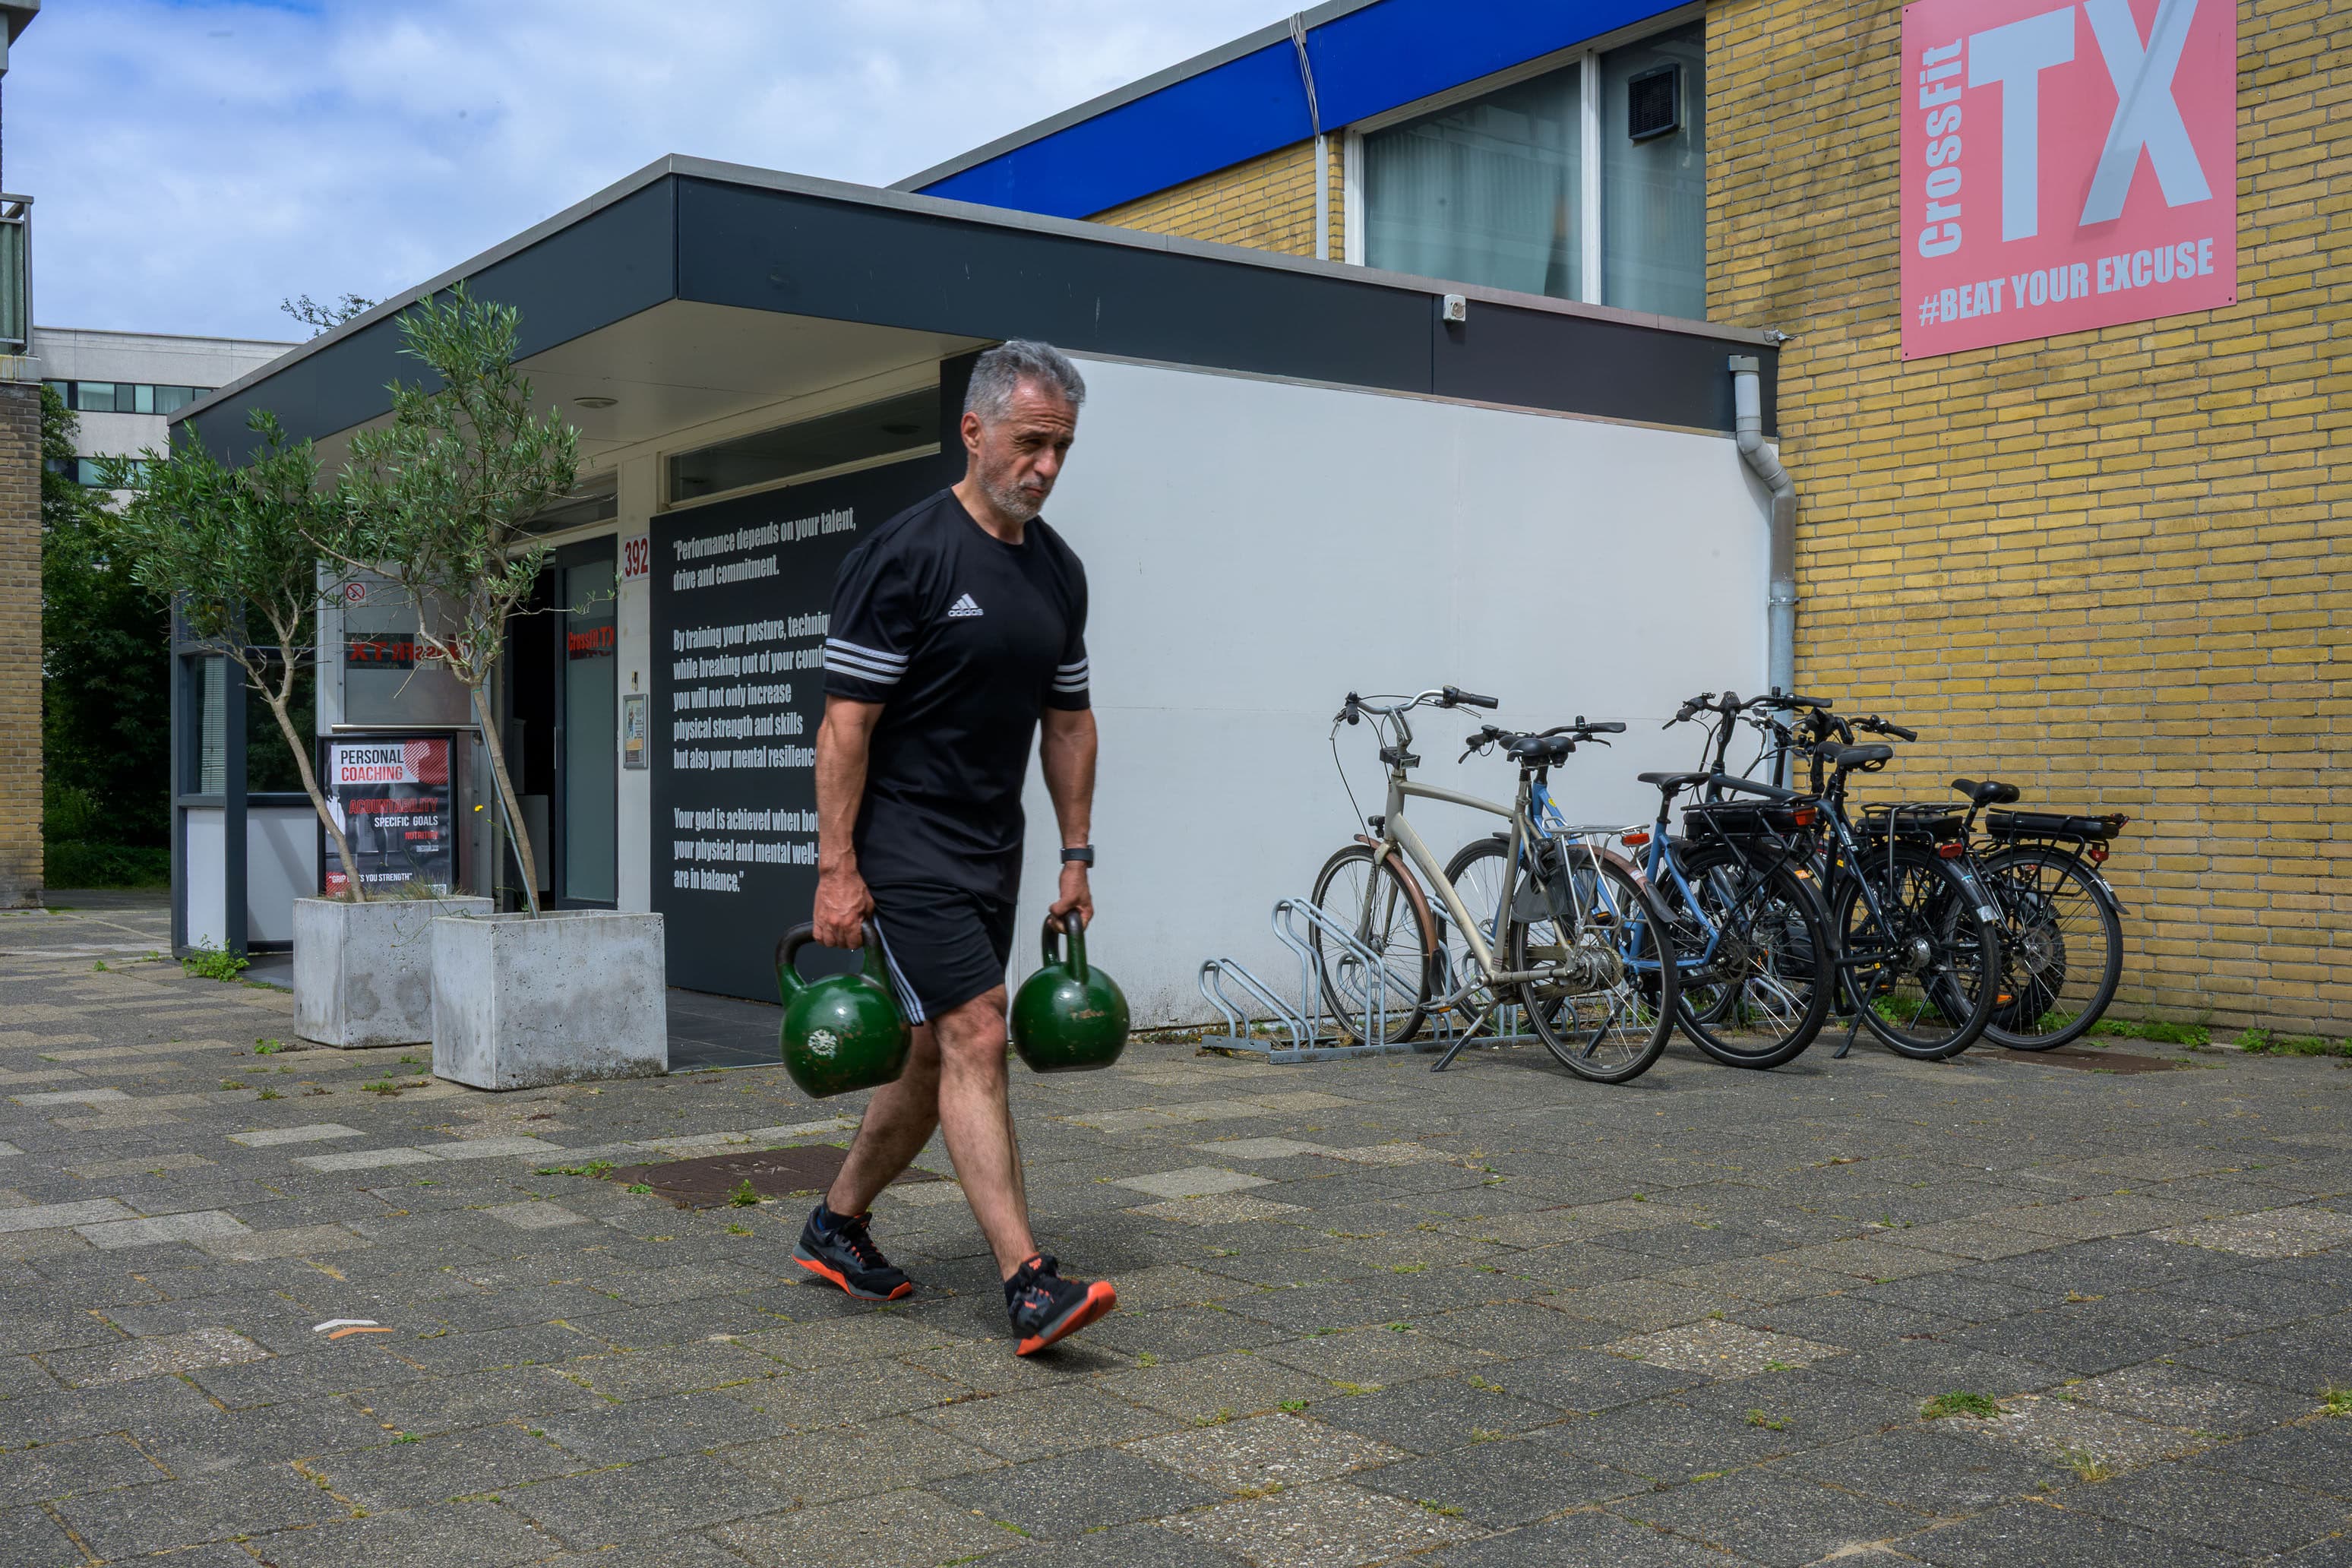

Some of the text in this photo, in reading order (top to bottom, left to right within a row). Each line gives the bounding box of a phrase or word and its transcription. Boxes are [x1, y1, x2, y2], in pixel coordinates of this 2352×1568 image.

[1968, 0, 2213, 242] TX
[1918, 38, 1962, 258] CrossFit
[1919, 238, 2214, 327] #BEAT YOUR EXCUSE
[736, 521, 779, 550] depends
[781, 521, 794, 542] on
[795, 516, 819, 541] your
[820, 507, 856, 534] talent,
[624, 537, 648, 577] 392
[673, 555, 779, 591] drive and commitment.
[674, 629, 686, 651] By
[686, 626, 722, 649] training
[723, 624, 744, 646] your
[745, 619, 786, 644] posture,
[674, 658, 698, 680] while
[699, 654, 740, 678] breaking
[741, 653, 757, 673] out
[759, 650, 770, 672] of
[770, 652, 795, 673] your
[673, 682, 792, 712] you will not only increase
[674, 712, 803, 741] physical strength and skills
[340, 749, 404, 765] PERSONAL
[674, 748, 689, 769] but
[690, 748, 710, 769] also
[710, 750, 731, 770] your
[732, 745, 767, 768] mental
[341, 766, 403, 781] COACHING
[374, 815, 438, 827] SPECIFIC GOALS
[674, 807, 694, 829] Your
[695, 808, 715, 831] goal
[716, 808, 726, 830] is
[726, 808, 770, 830] achieved
[772, 809, 800, 832] when
[674, 840, 694, 861] your
[695, 838, 734, 861] physical
[735, 839, 754, 861] and
[755, 841, 791, 864] mental
[365, 874, 378, 882] YOU
[674, 870, 689, 889] are
[691, 868, 700, 889] in
